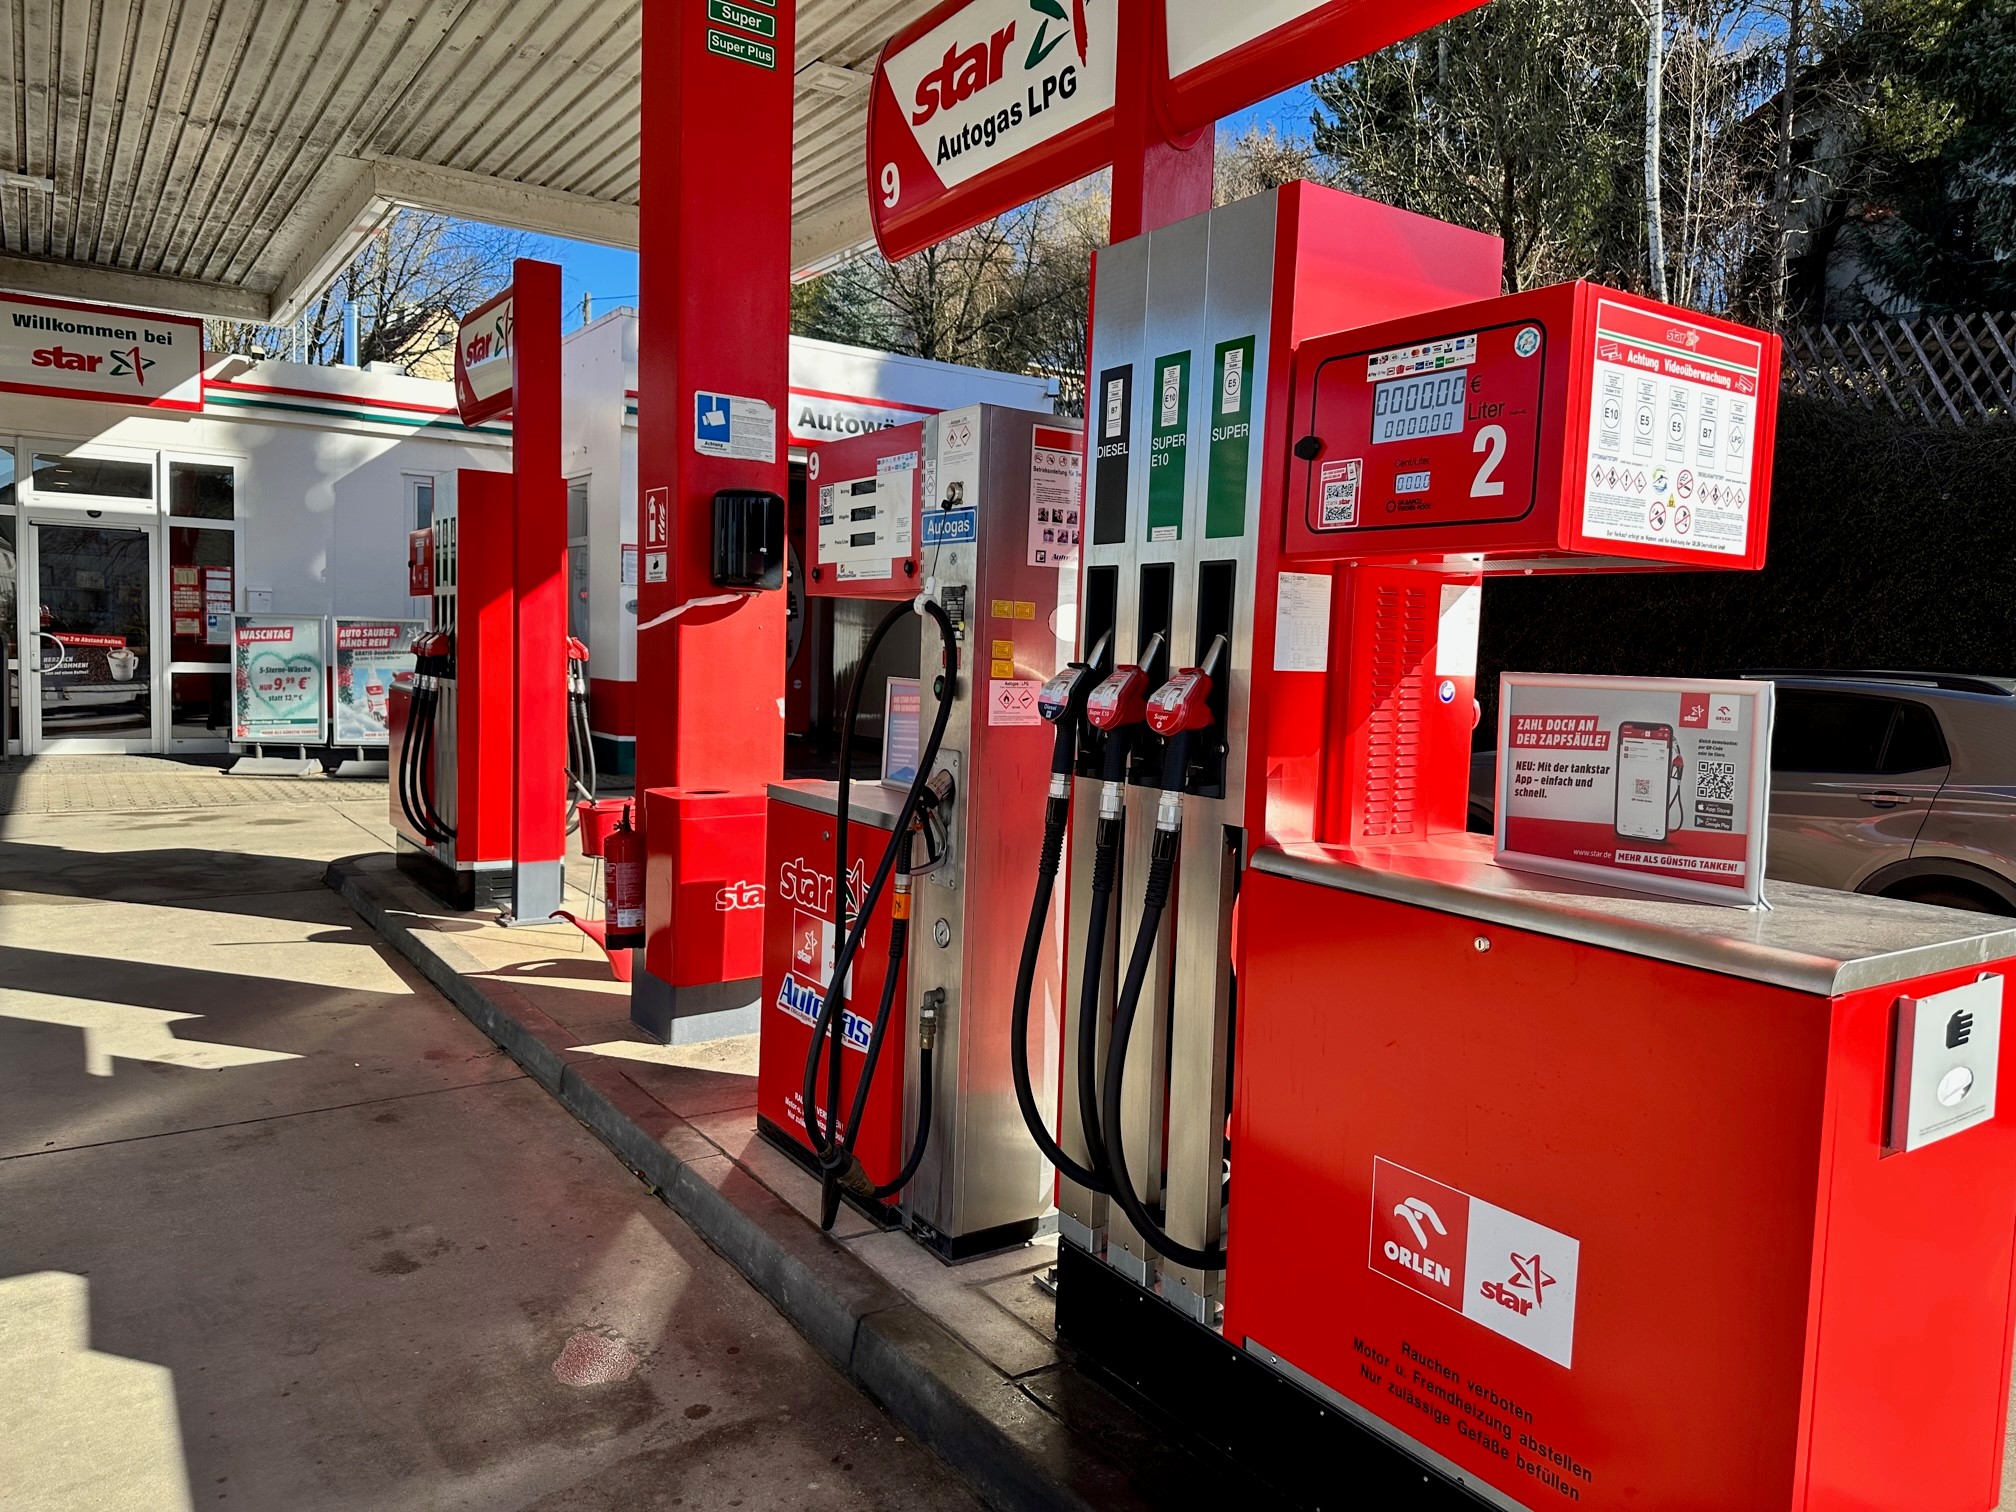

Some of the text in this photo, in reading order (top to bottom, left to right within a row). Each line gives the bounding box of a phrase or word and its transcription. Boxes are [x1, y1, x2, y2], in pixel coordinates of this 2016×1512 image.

[722, 5, 762, 28] Super
[711, 34, 772, 61] Super Plus
[912, 20, 1016, 127] star
[936, 65, 1077, 166] Autogas LPG
[880, 162, 900, 208] 9
[11, 312, 173, 346] Willkommen bei
[1666, 328, 1686, 344] star
[465, 324, 493, 368] star
[31, 345, 103, 373] star
[1627, 349, 1731, 389] Achtung Videoüberwachung
[458, 380, 466, 403] 4
[1228, 378, 1237, 388] E5
[1471, 375, 1483, 394] €
[1165, 393, 1176, 403] E10
[1467, 401, 1506, 421] Liter
[1604, 407, 1619, 420] E10
[1640, 415, 1650, 426] E5
[1672, 421, 1682, 433] E5
[1211, 423, 1249, 442] SUPER
[1702, 428, 1712, 439] B7
[1731, 436, 1742, 444] LPG
[1097, 442, 1129, 459] DIESEL
[1152, 433, 1186, 451] SUPER
[808, 451, 820, 480] 9
[1151, 453, 1169, 468] E10
[1469, 424, 1507, 498] 2
[927, 518, 970, 537] Autogas
[80, 636, 104, 644] Abstand
[240, 629, 291, 640] WASCHTAG
[339, 628, 398, 638] AUTO SAUBER,
[339, 637, 388, 648] HÄNDE REIN
[259, 666, 312, 674] 5-Sterne-Wäsche
[1089, 708, 1101, 717] Super
[1153, 713, 1169, 721] Super
[1517, 718, 1595, 732] ZAHL DOCH AN
[1516, 732, 1607, 747] DER ZAPFSÄULE!
[1515, 760, 1611, 775] NEU: Mit der tankstar
[1514, 774, 1532, 785] App
[1540, 775, 1574, 787] einfach
[1574, 777, 1594, 788] und
[1514, 787, 1548, 799] schnell.
[1704, 820, 1731, 830] Google Play
[1573, 848, 1612, 859] www.star.de
[1617, 851, 1738, 872] MEHR ALS GÜNSTIG TANKEN!
[780, 857, 834, 912] star
[715, 880, 766, 911] sta
[797, 949, 812, 964] star
[1383, 1240, 1451, 1287] ORLEN
[1480, 1279, 1533, 1317] star
[1401, 1342, 1534, 1425] Rauchen verboten
[1353, 1337, 1593, 1484] Motor u. Fremdheizung abstellen
[1359, 1363, 1580, 1503] Nur zulässige Gefäße befüllen
